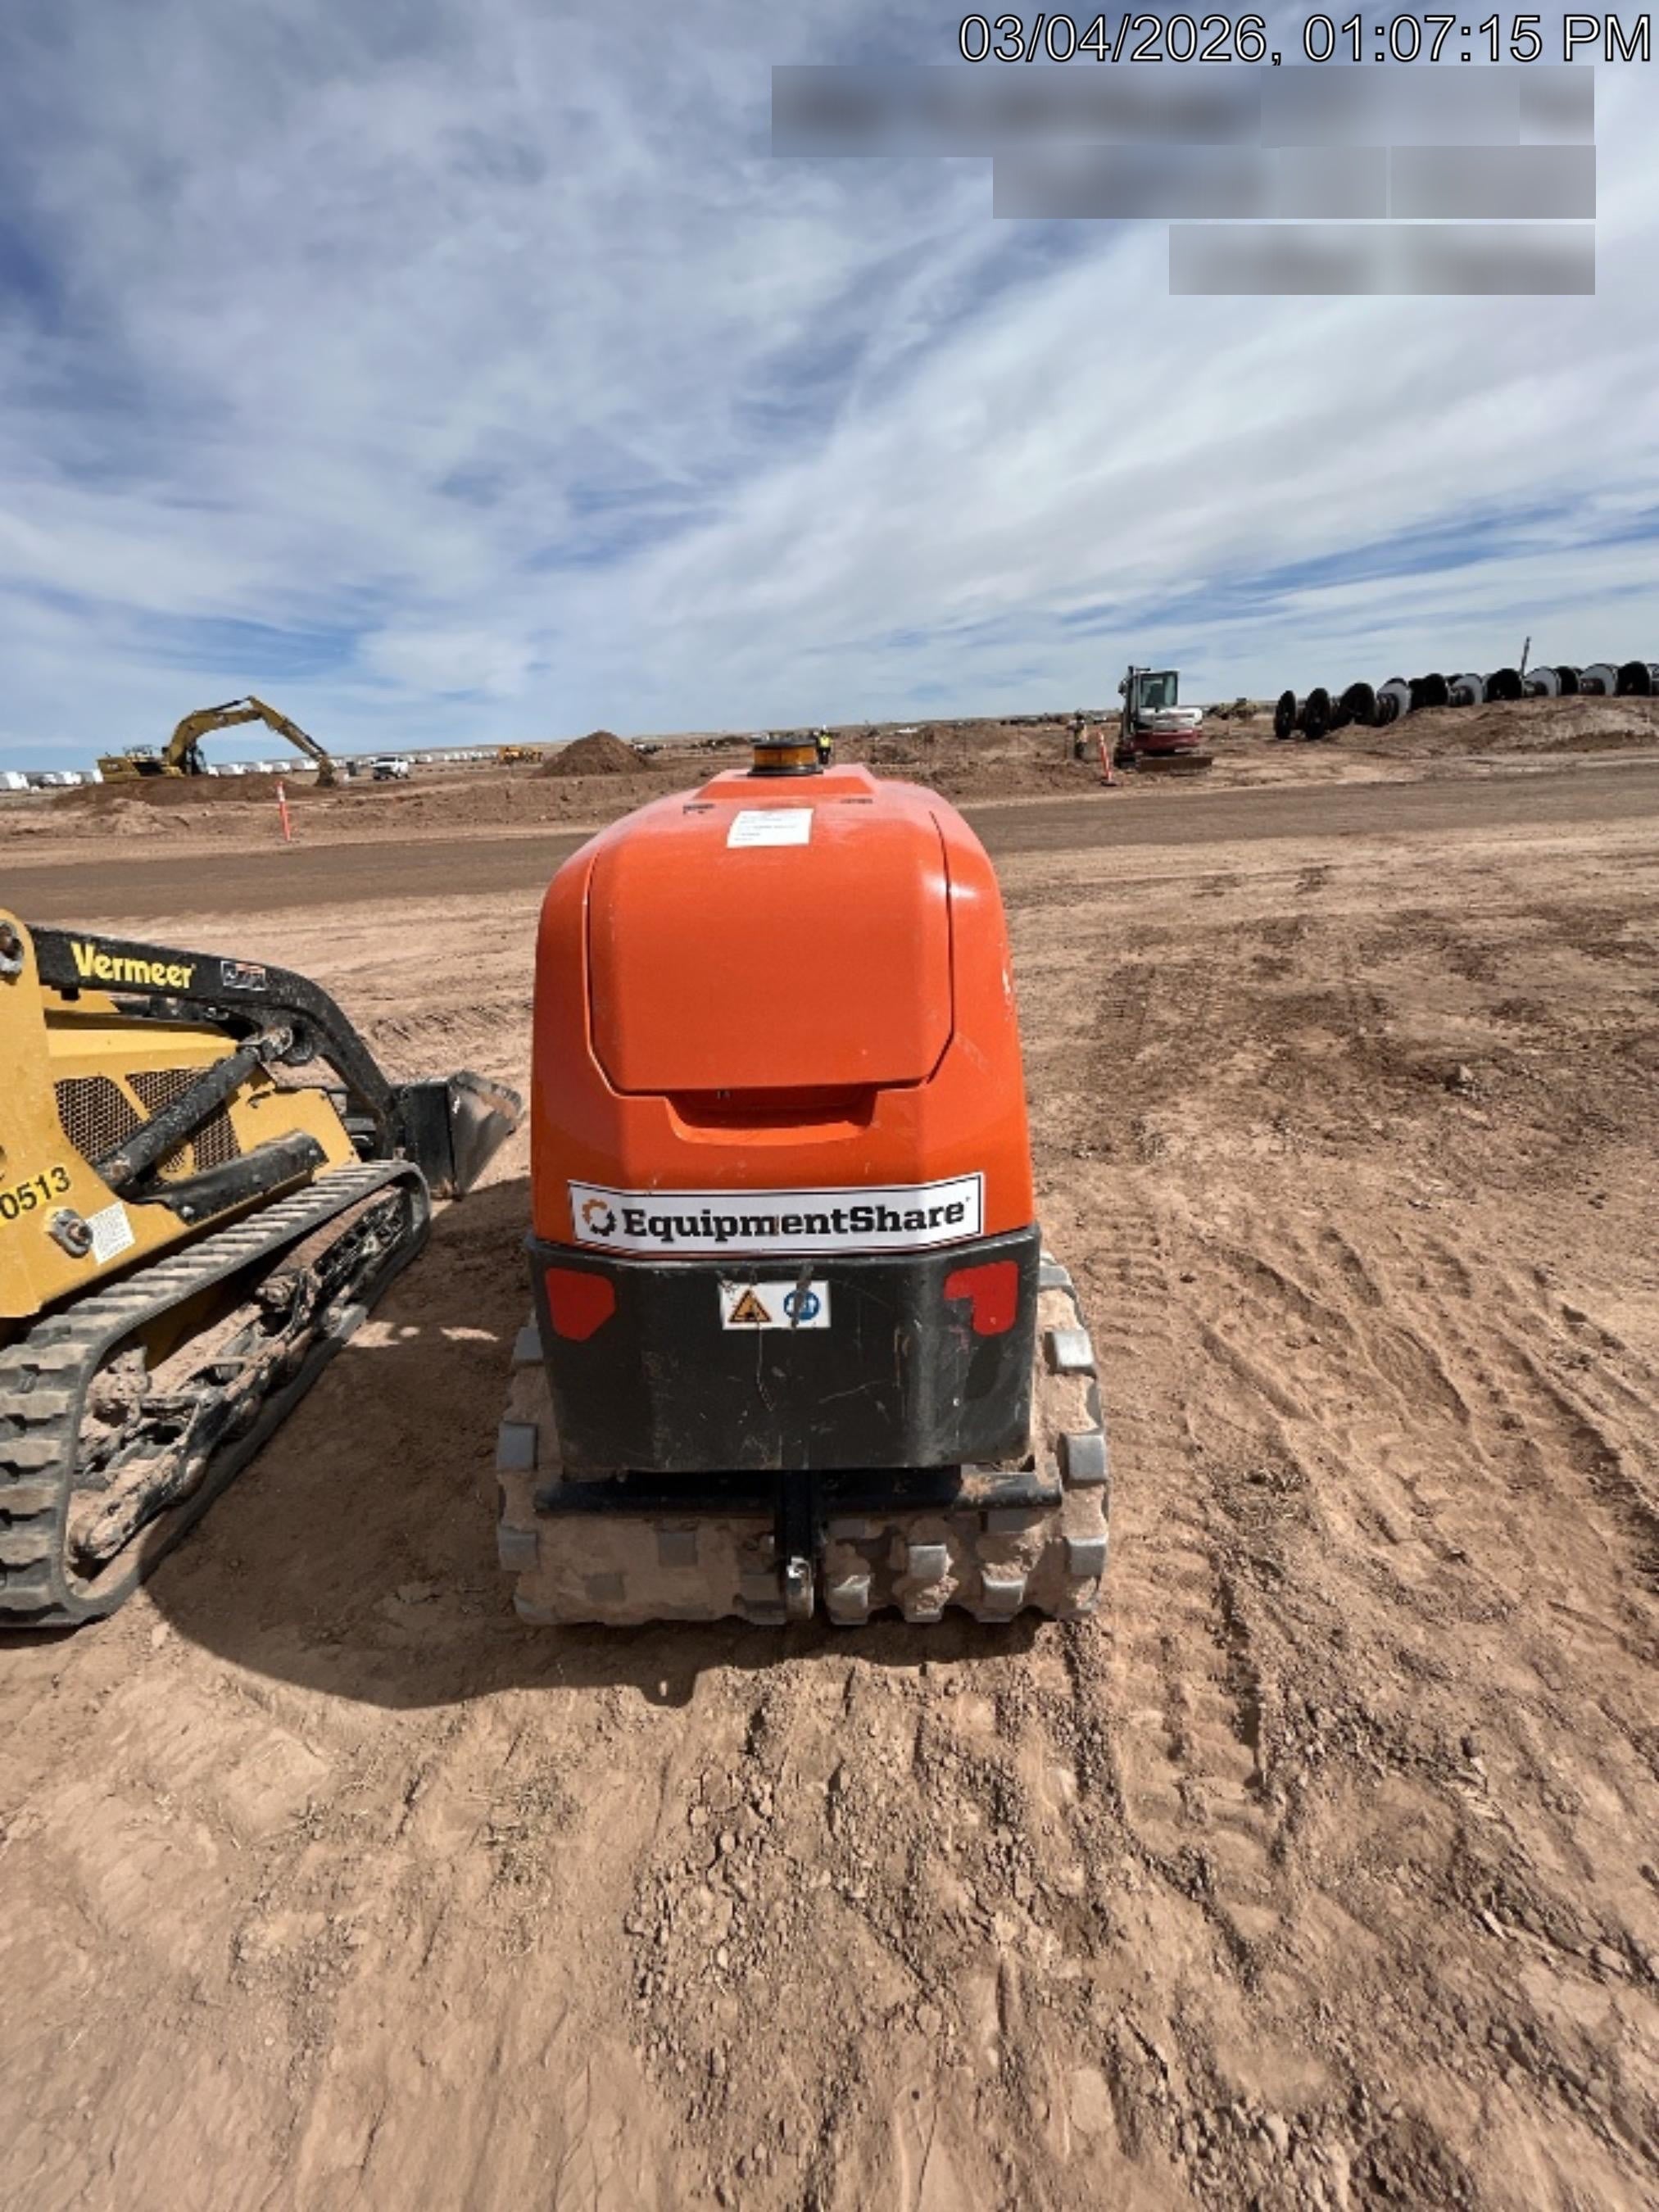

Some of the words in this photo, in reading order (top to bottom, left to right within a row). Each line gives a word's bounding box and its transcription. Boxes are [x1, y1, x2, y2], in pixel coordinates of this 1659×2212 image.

[71, 942, 193, 988] Vermeer
[0, 1167, 70, 1219] 0513
[622, 1202, 964, 1242] EquipmentShare
